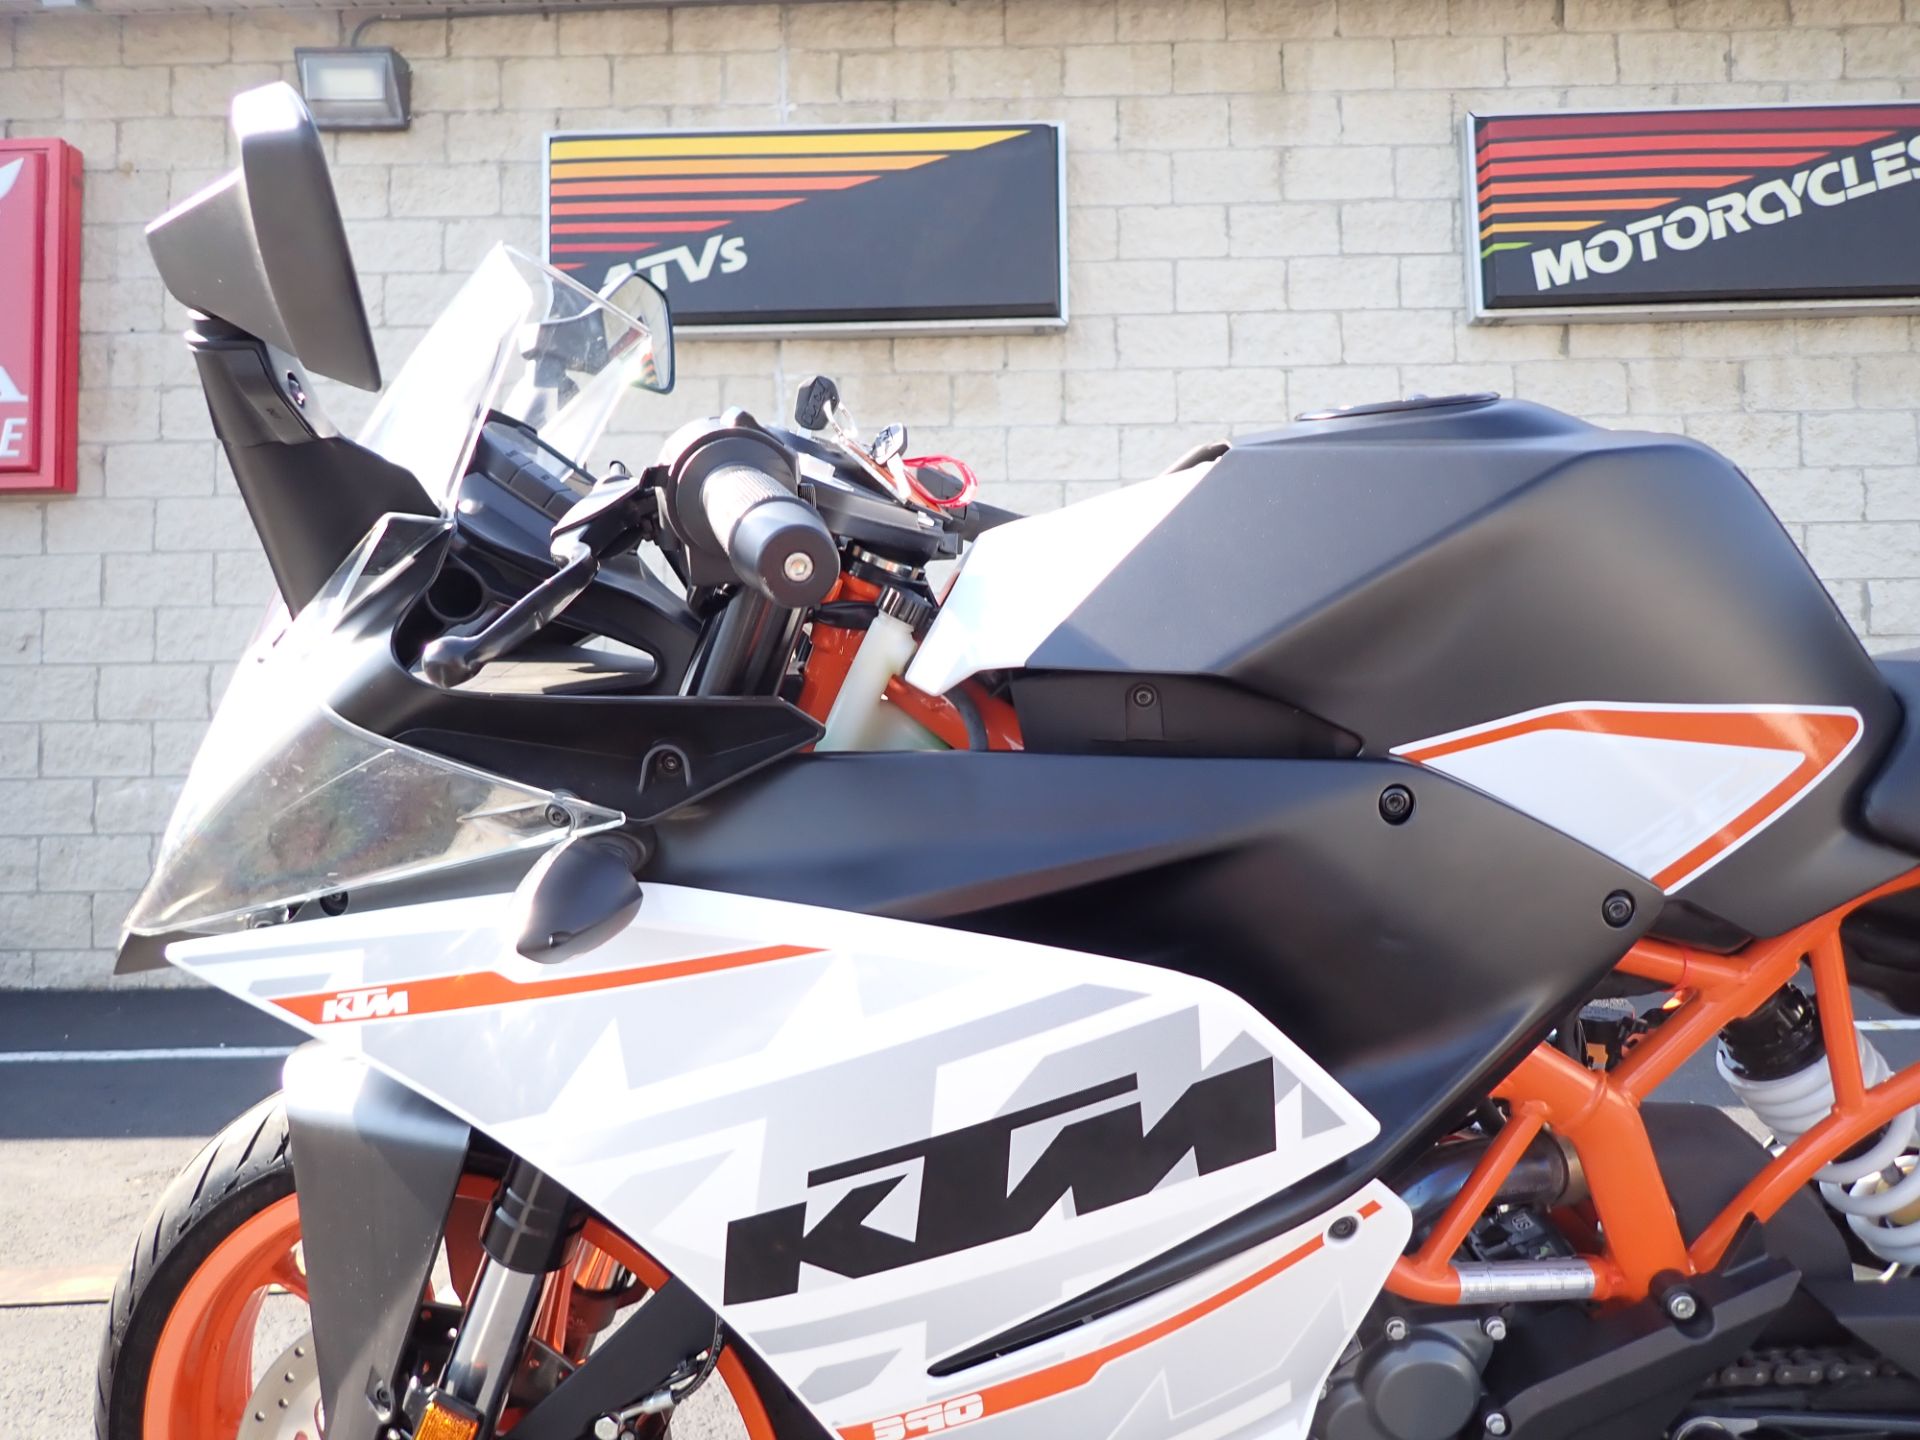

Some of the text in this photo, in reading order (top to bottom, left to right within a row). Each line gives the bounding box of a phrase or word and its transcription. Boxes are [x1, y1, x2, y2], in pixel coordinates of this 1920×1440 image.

[322, 987, 409, 1023] KTM
[723, 1056, 1277, 1306] KTM
[872, 1393, 984, 1440] 390
